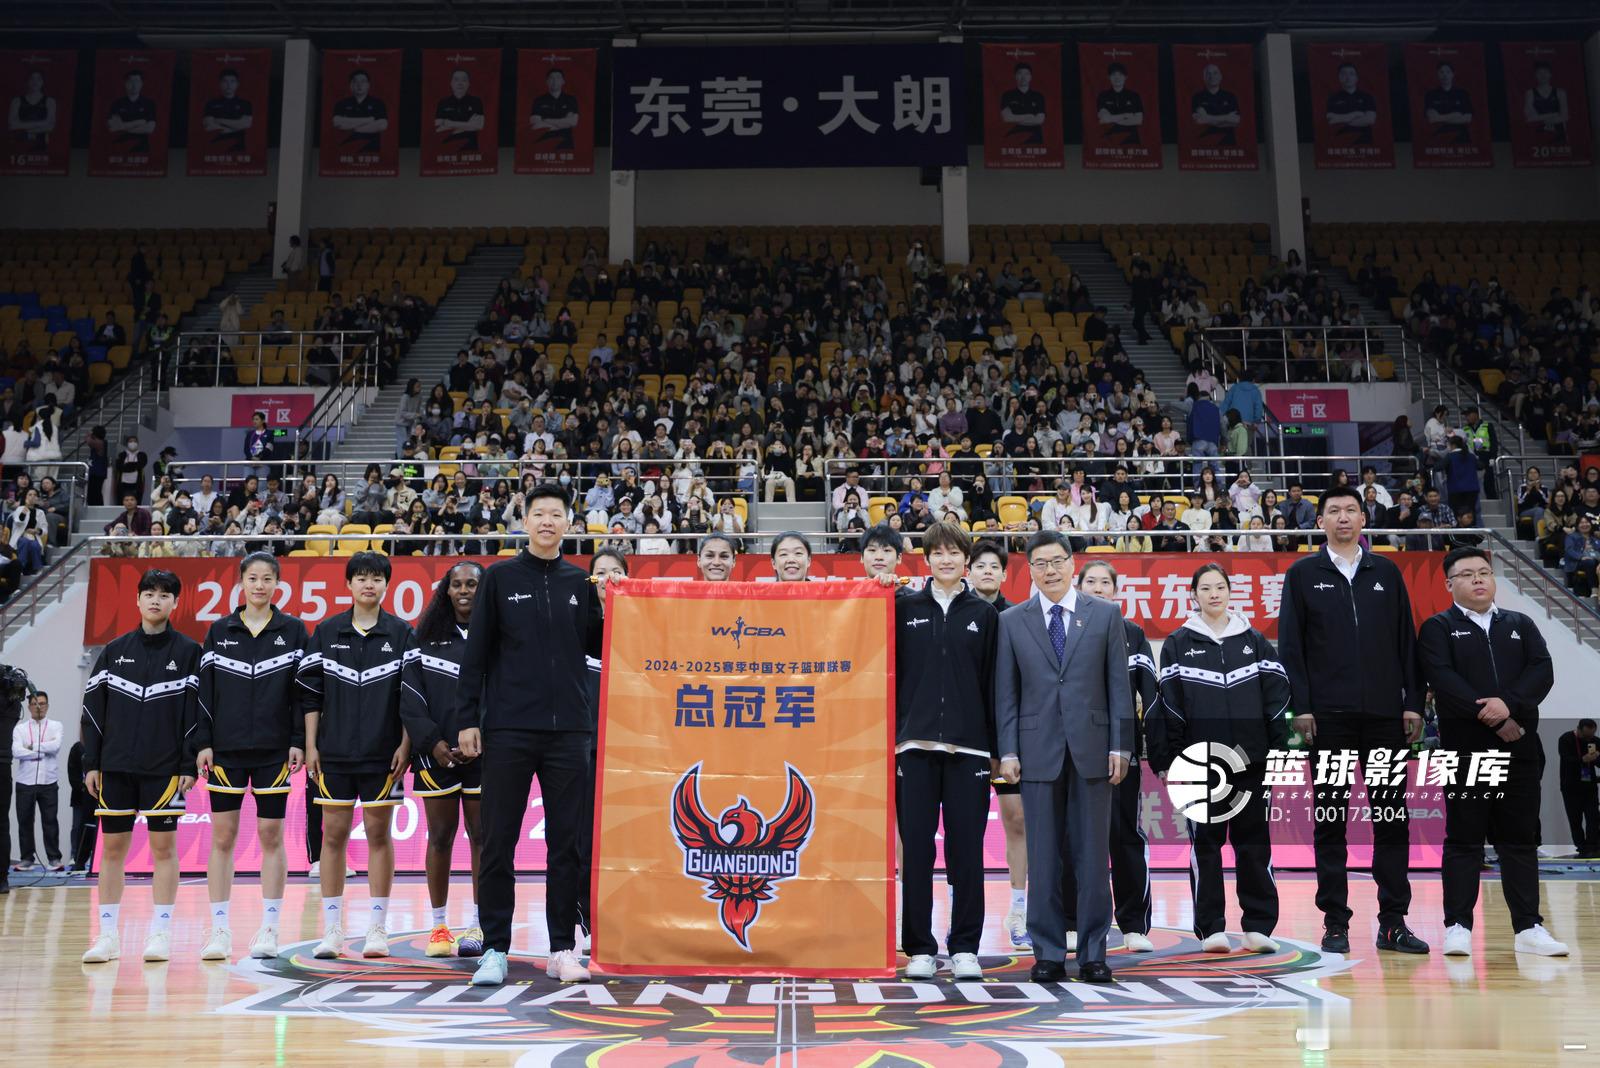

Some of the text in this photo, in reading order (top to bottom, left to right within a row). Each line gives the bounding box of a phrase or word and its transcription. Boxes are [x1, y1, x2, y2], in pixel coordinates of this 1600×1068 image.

[630, 75, 951, 138] 东莞·大朗
[1290, 403, 1327, 419] 西区
[711, 623, 786, 641] WCBA
[645, 659, 852, 674] 2024-2025赛季中国女子篮球联赛
[675, 683, 816, 729] 总冠军
[687, 848, 796, 874] GUANGDONG
[280, 978, 1300, 1006] GUANGDONG
